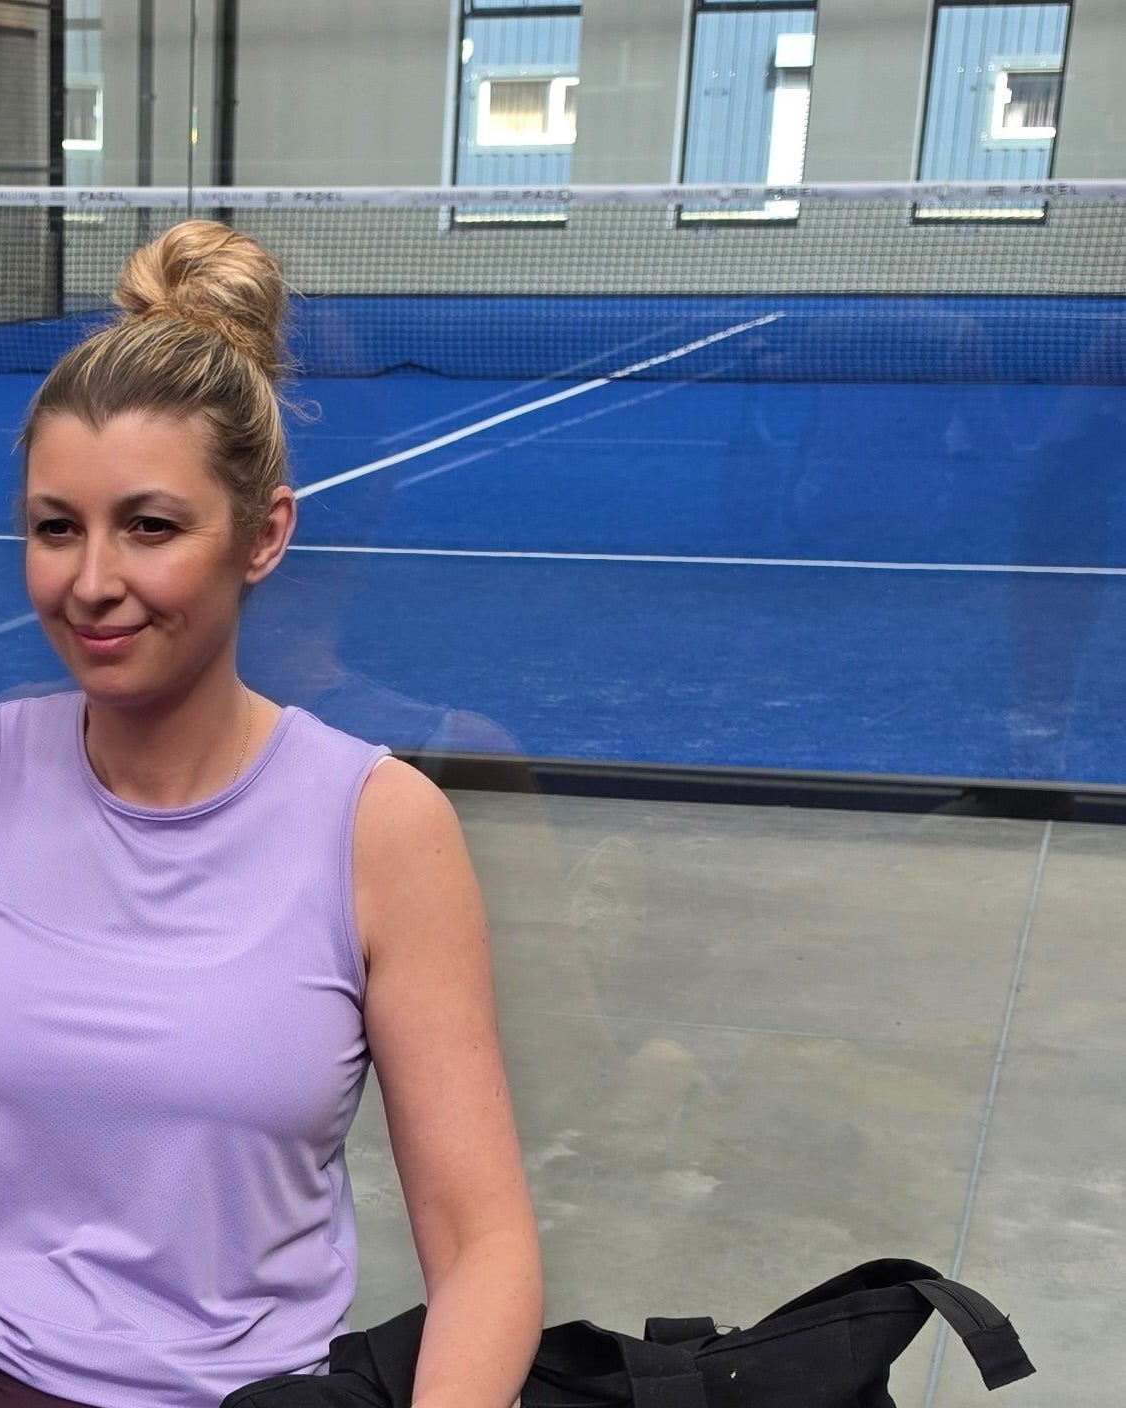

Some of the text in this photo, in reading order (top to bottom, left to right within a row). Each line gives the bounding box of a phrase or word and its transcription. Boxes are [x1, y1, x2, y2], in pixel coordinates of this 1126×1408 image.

[1020, 184, 1080, 196] PADEL
[77, 191, 124, 201] PADEL
[293, 191, 345, 201] PADEL
